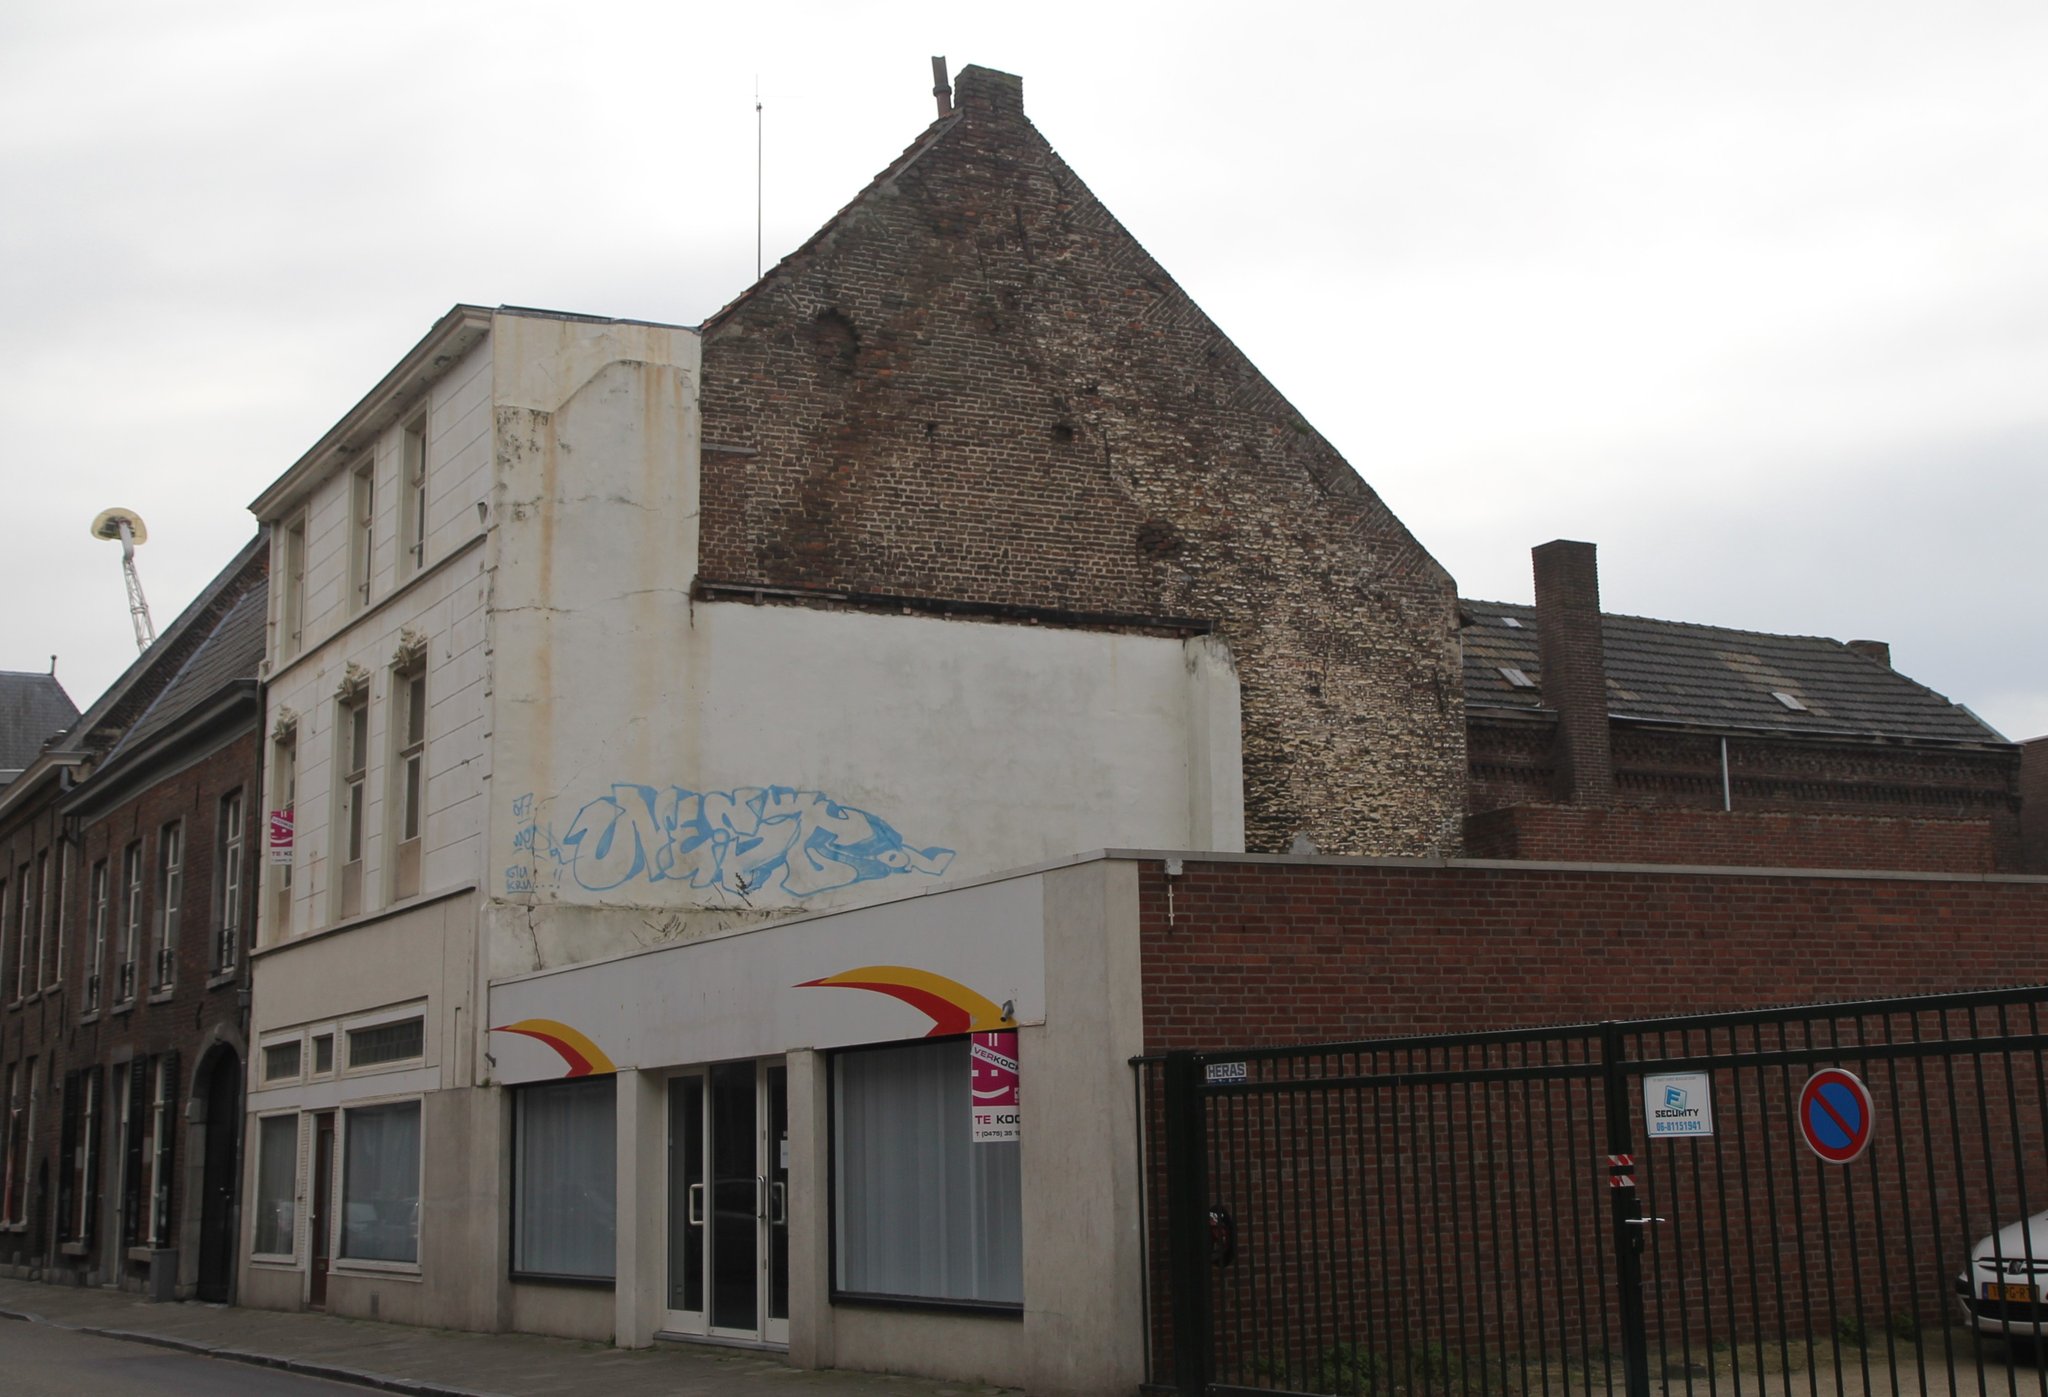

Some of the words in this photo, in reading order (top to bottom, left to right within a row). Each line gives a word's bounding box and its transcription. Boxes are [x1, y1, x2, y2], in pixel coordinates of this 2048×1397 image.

[974, 1046, 1018, 1071] VERKOC
[1208, 1064, 1245, 1078] HERAS
[1655, 1108, 1699, 1118] SECURITY
[975, 1114, 991, 1125] TE
